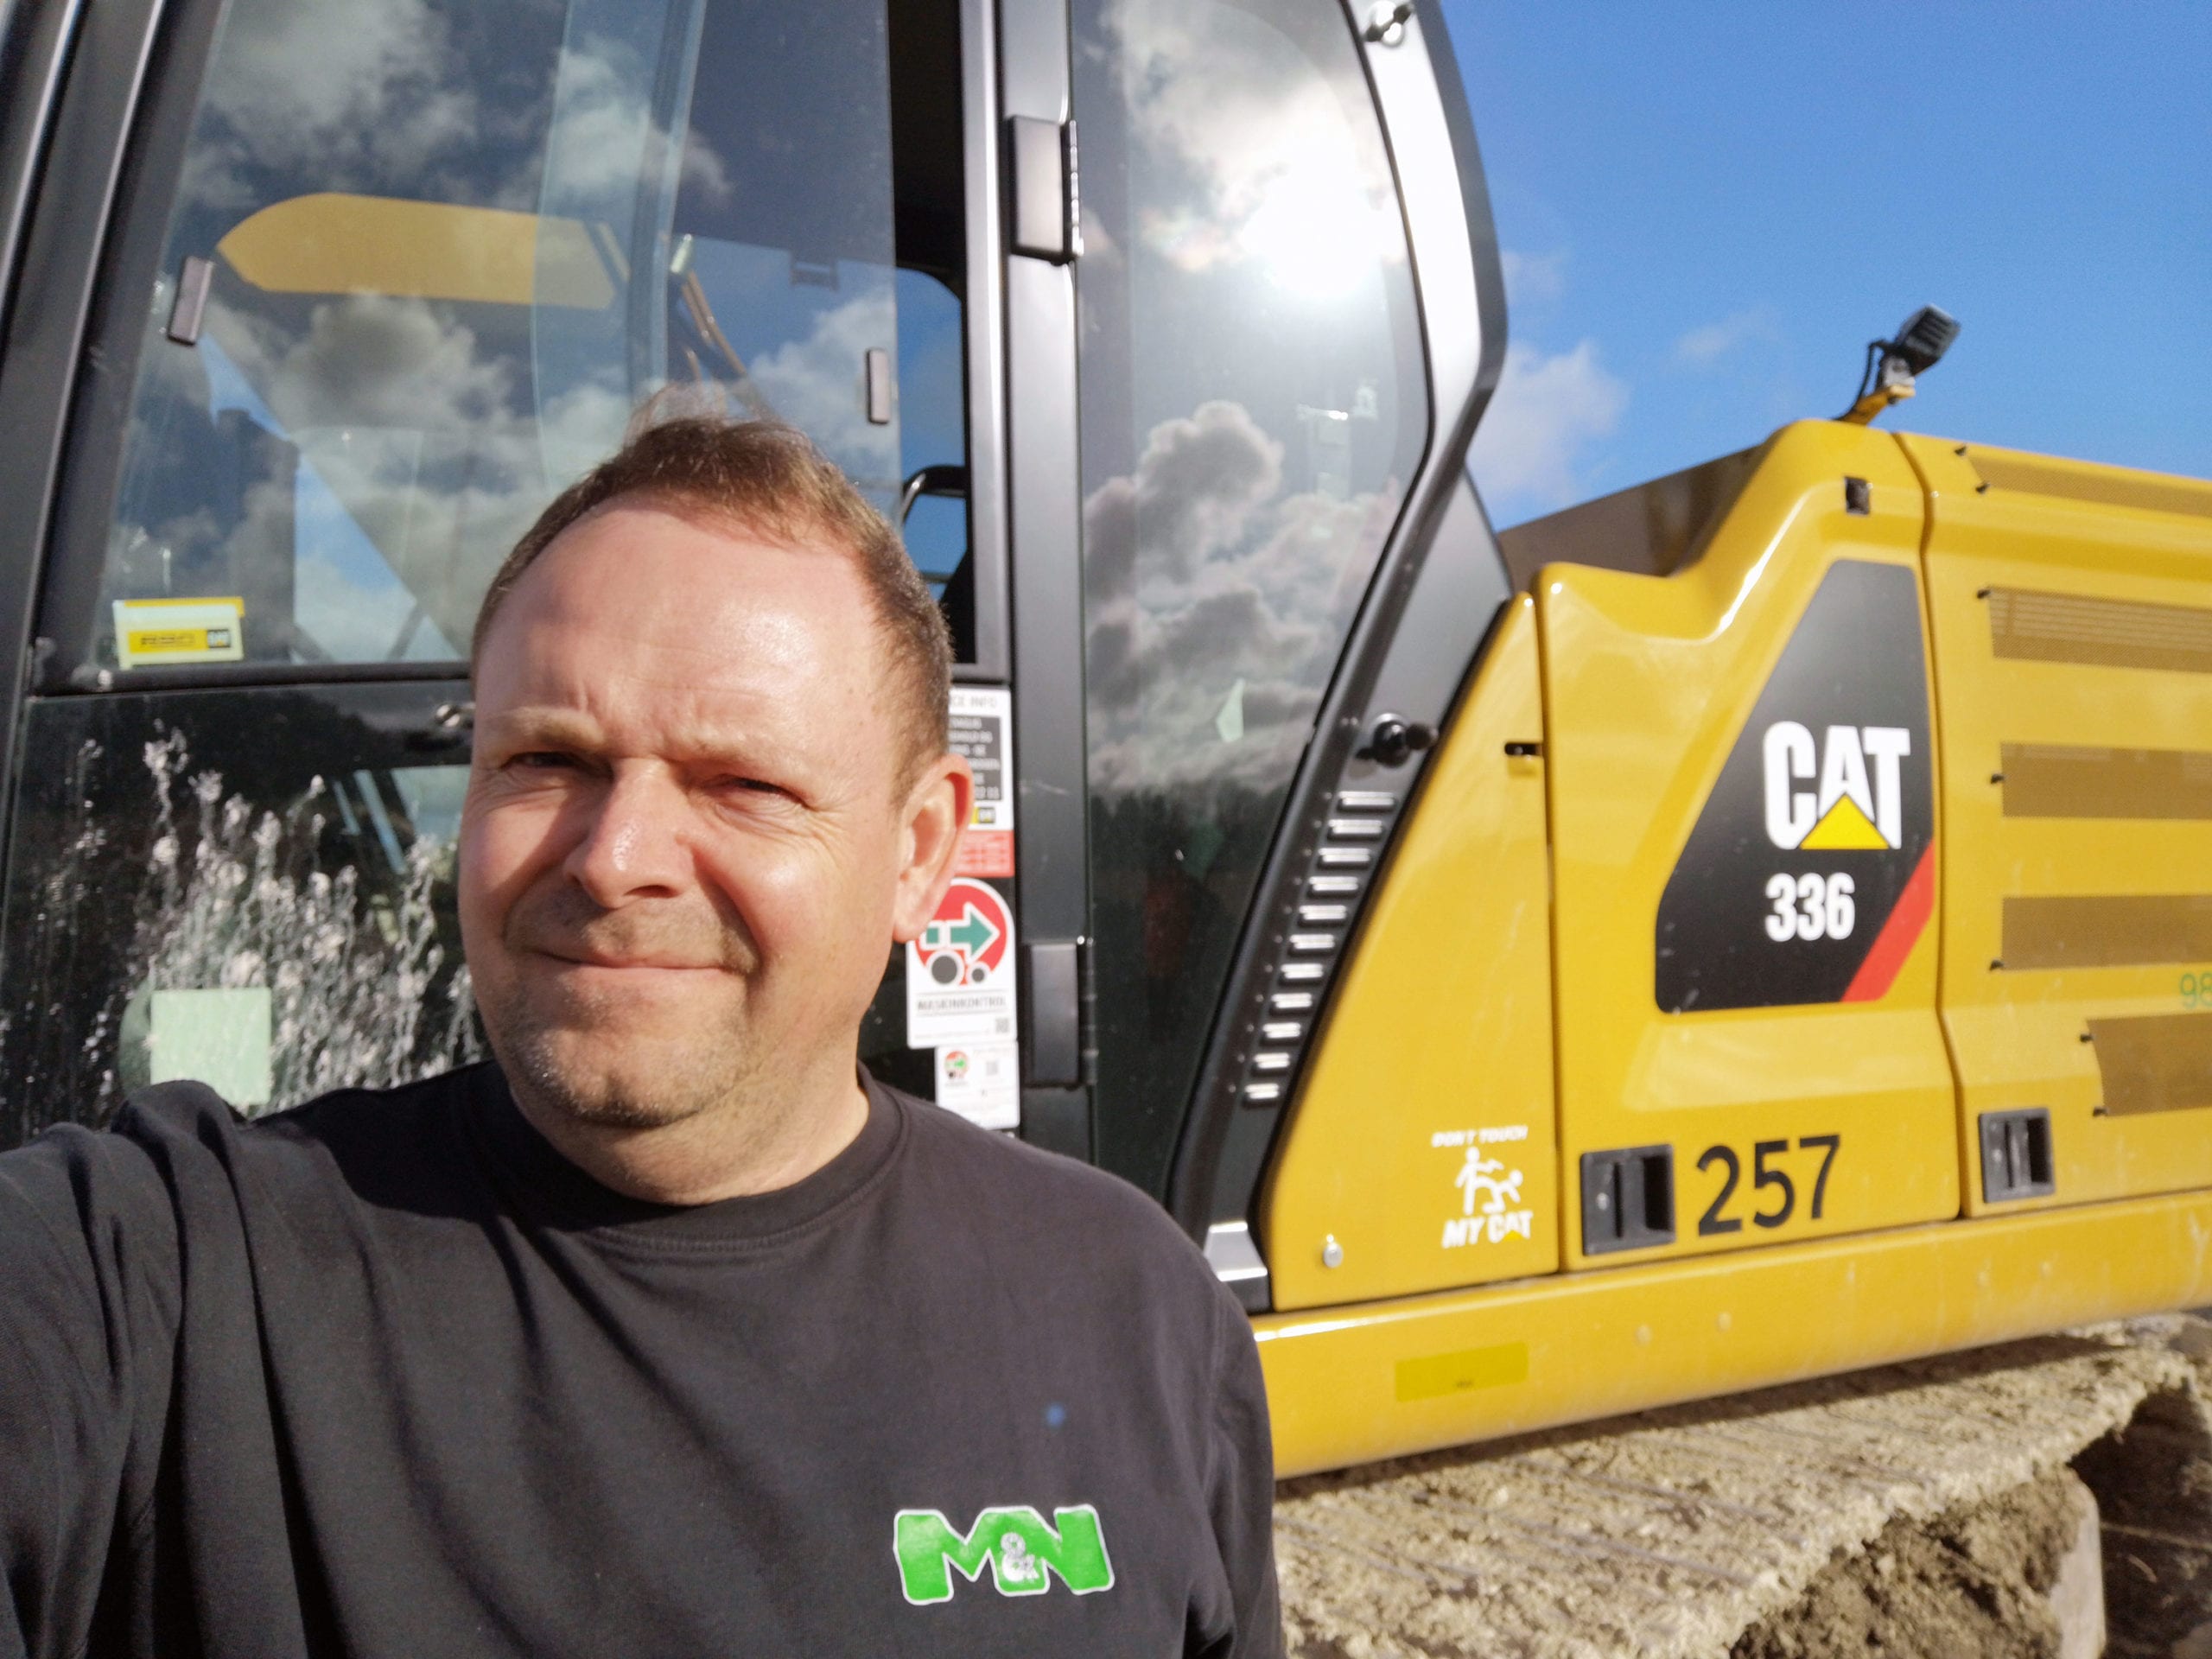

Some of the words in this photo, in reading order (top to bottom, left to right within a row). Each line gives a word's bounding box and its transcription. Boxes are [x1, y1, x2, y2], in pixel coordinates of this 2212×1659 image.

[1764, 721, 1910, 849] CAT
[1764, 873, 1856, 942] 336
[1478, 1125, 1529, 1143] TOUCH
[1695, 1135, 1841, 1237] 257
[1441, 1217, 1485, 1249] MY
[1487, 1210, 1534, 1243] CAT
